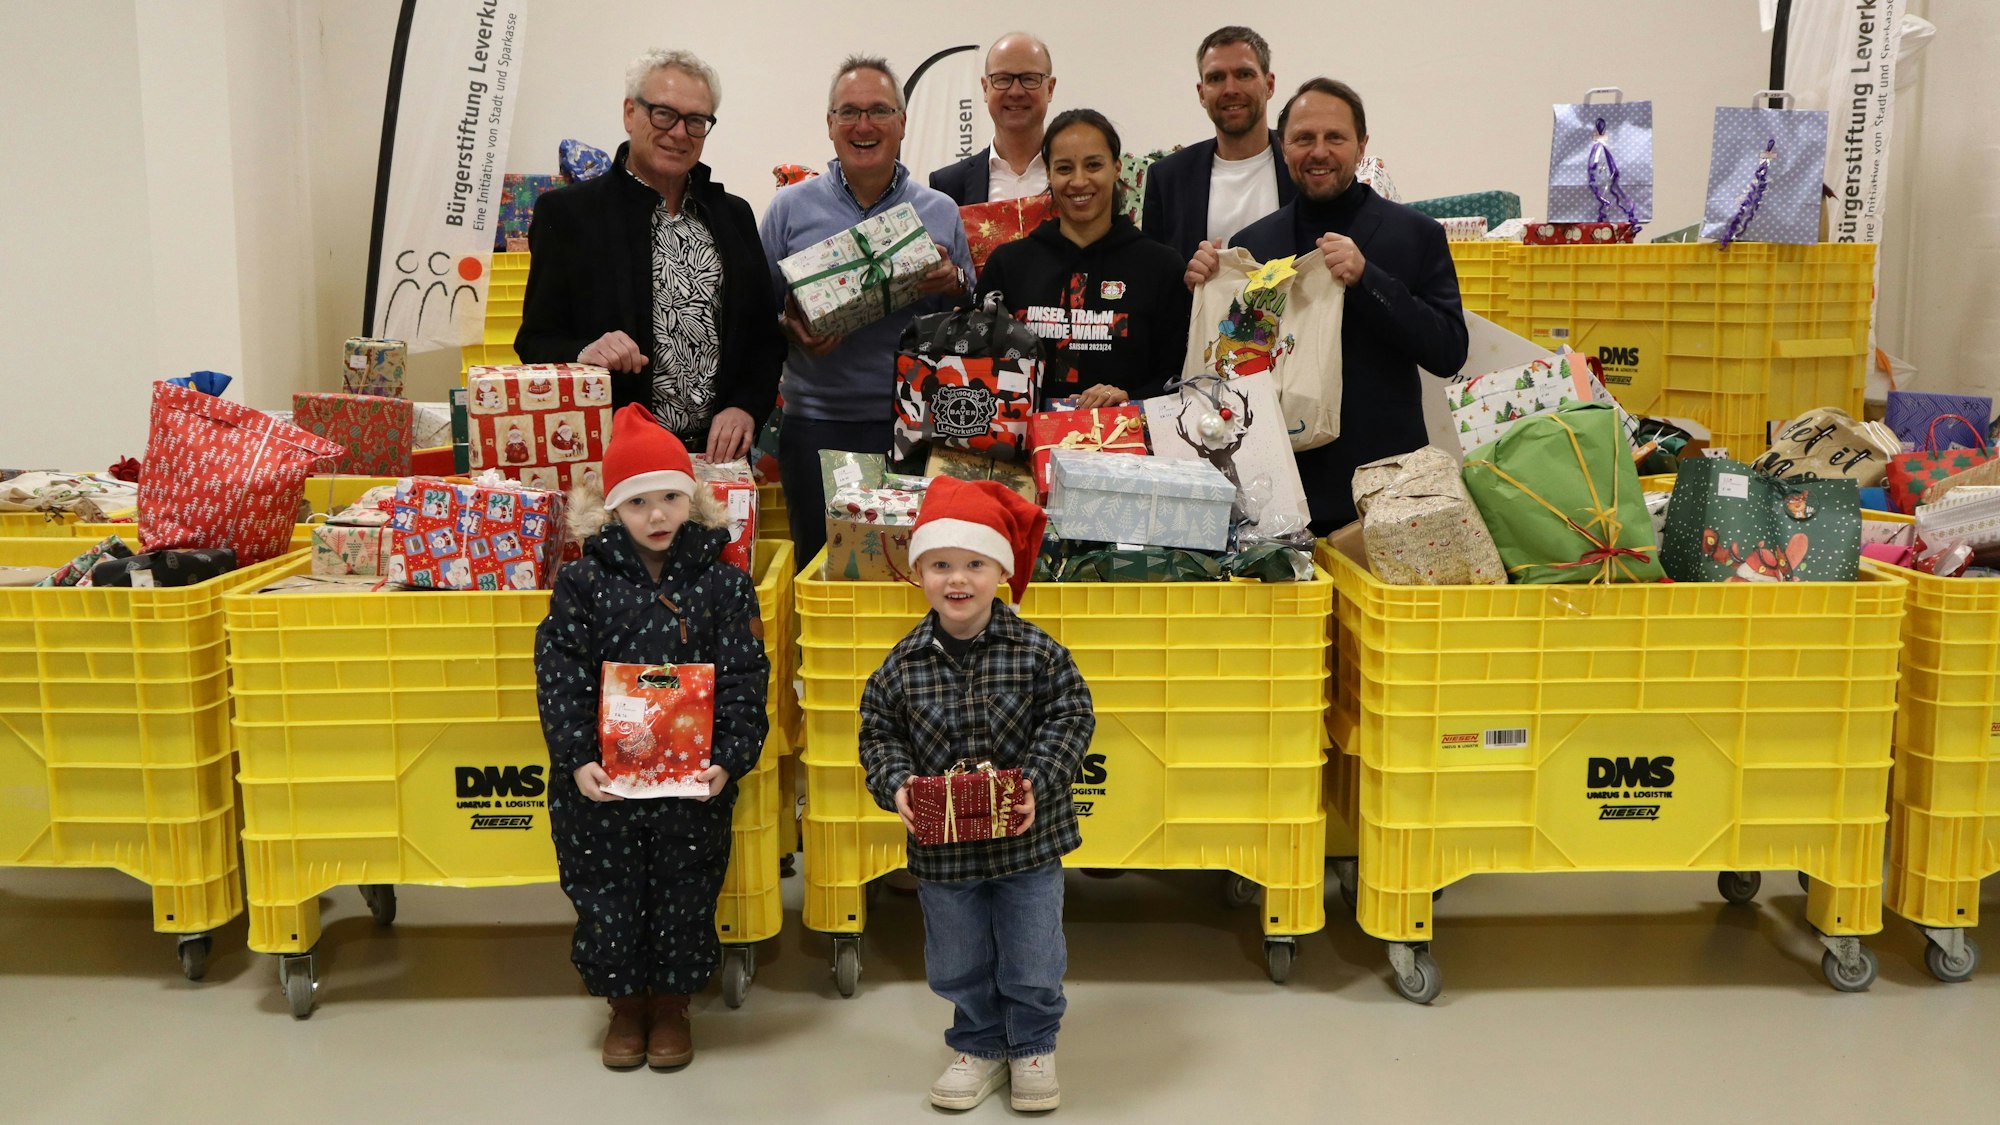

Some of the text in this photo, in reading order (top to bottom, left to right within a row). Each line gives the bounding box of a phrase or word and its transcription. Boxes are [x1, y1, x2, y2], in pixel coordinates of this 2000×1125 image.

[1880, 64, 1889, 88] und
[1875, 92, 1888, 126] Stadt
[473, 13, 517, 231] Eine Initiative von Stadt und Sparkasse
[955, 98, 973, 160] kusen
[1874, 132, 1882, 154] von
[446, 80, 488, 227] Bürgerstiftung
[1865, 160, 1880, 218] Initiative
[1864, 223, 1875, 243] ine
[1026, 306, 1115, 324] UNSER. TRAUM
[1071, 324, 1113, 340] WAHR.
[1069, 343, 1088, 351] SAISON
[1598, 346, 1639, 366] DMS
[941, 423, 983, 435] Leverkusen
[455, 764, 545, 798] DMS
[1587, 756, 1675, 788] DMS
[1072, 788, 1106, 796] OGISTIK
[506, 800, 545, 808] LOGISTIK
[1600, 807, 1659, 818] NIESEN
[472, 816, 531, 828] NIESEN
